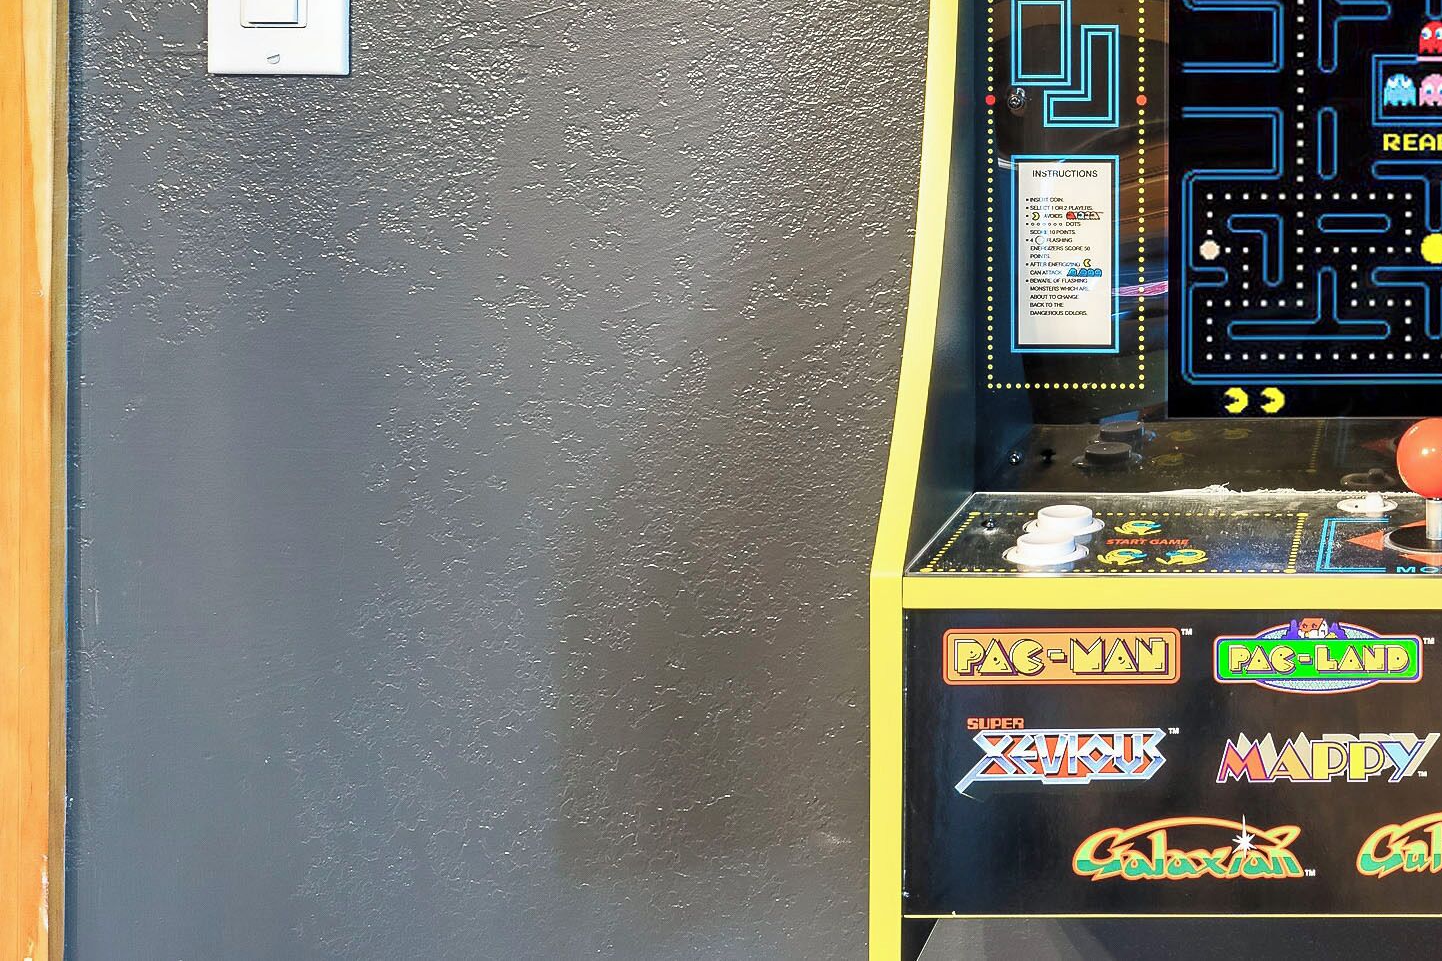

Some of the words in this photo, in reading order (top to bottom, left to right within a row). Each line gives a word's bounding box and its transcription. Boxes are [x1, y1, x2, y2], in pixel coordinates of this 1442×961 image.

[954, 637, 1168, 676] PAC-MAN
[1229, 644, 1410, 674] PAC-LAND
[967, 718, 1024, 729] SUPER
[955, 728, 1166, 794] XEVIOUS
[1217, 732, 1440, 782] MAPPY
[1073, 817, 1305, 881] Galaxian
